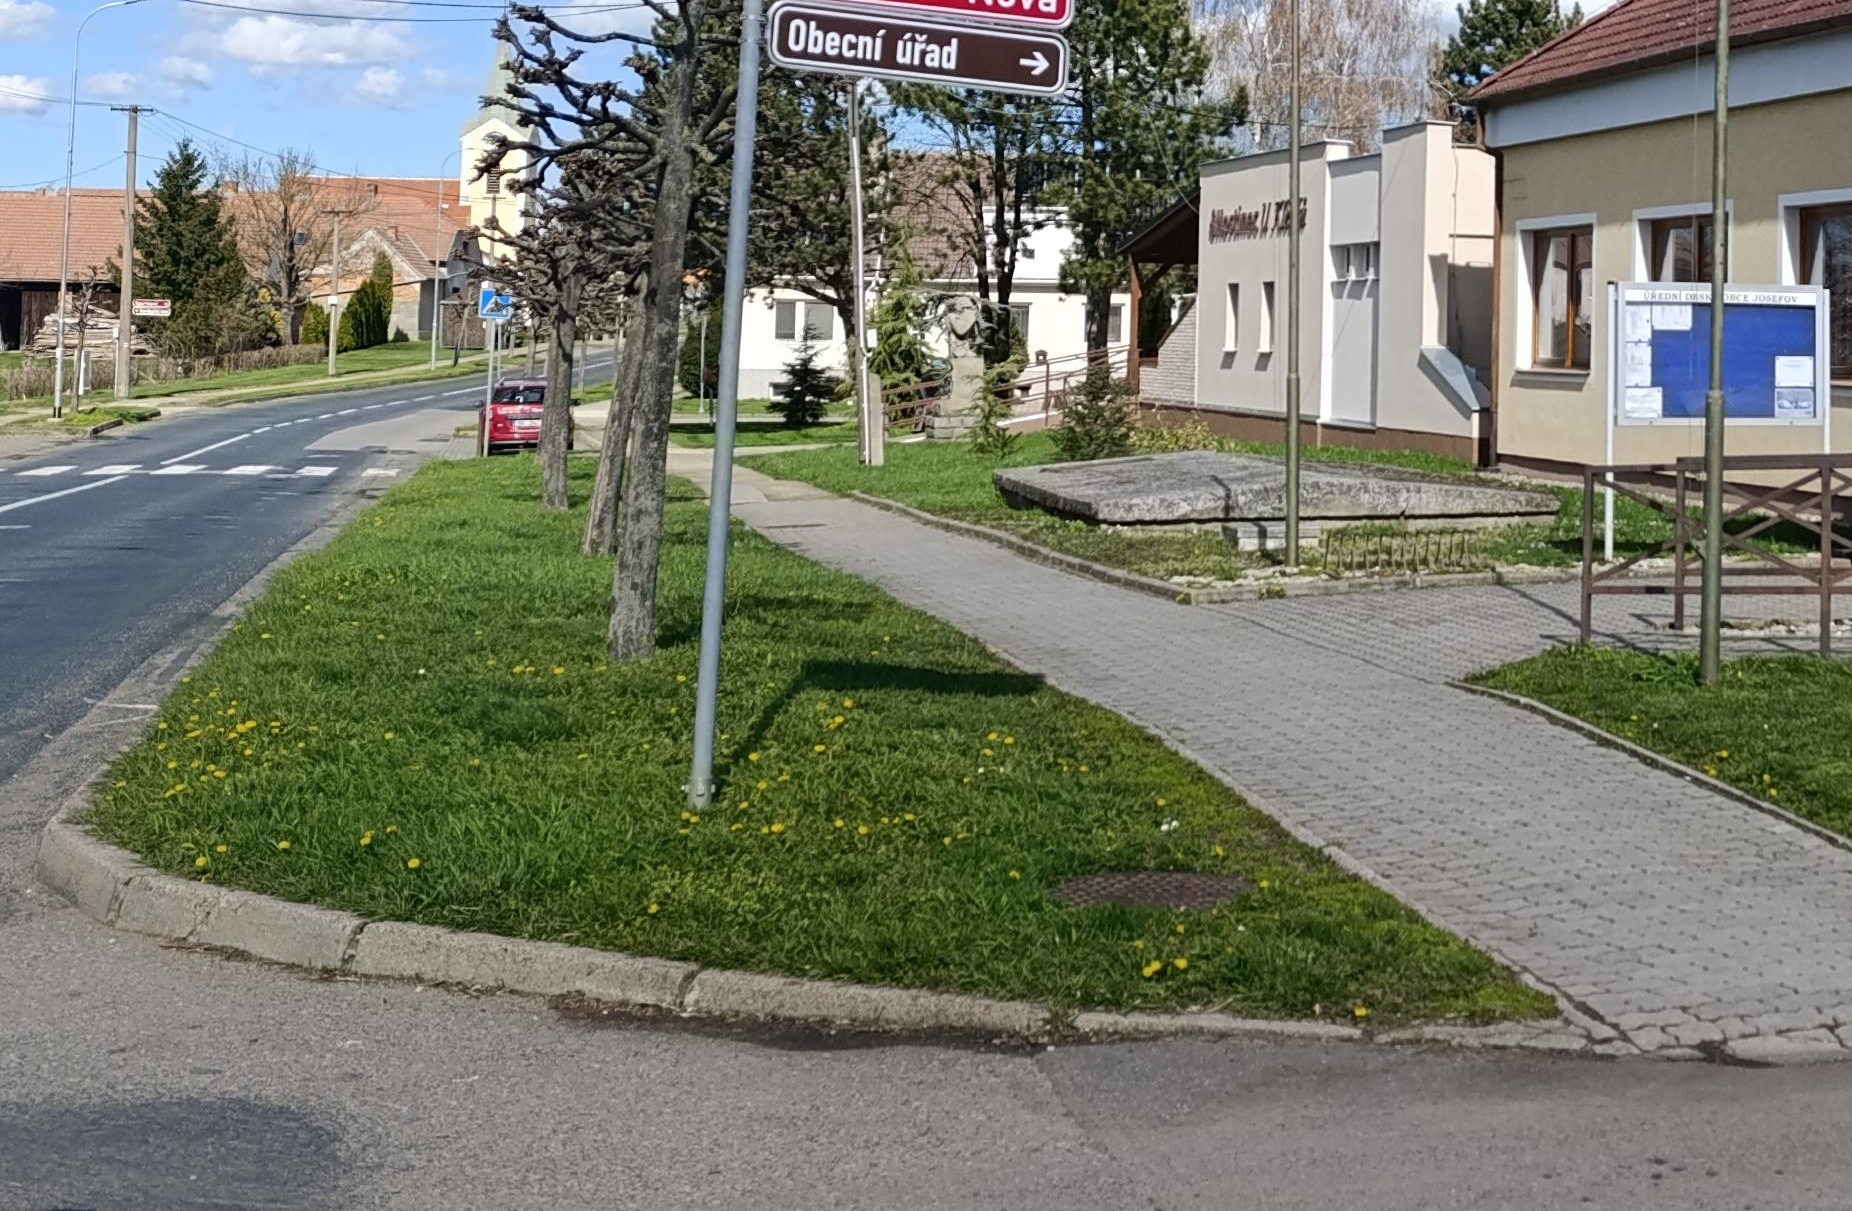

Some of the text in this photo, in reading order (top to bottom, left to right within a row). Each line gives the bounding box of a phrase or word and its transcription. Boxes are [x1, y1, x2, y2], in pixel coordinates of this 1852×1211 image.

[787, 19, 959, 70] Obecní úřad
[1685, 292, 1713, 301] DESK
